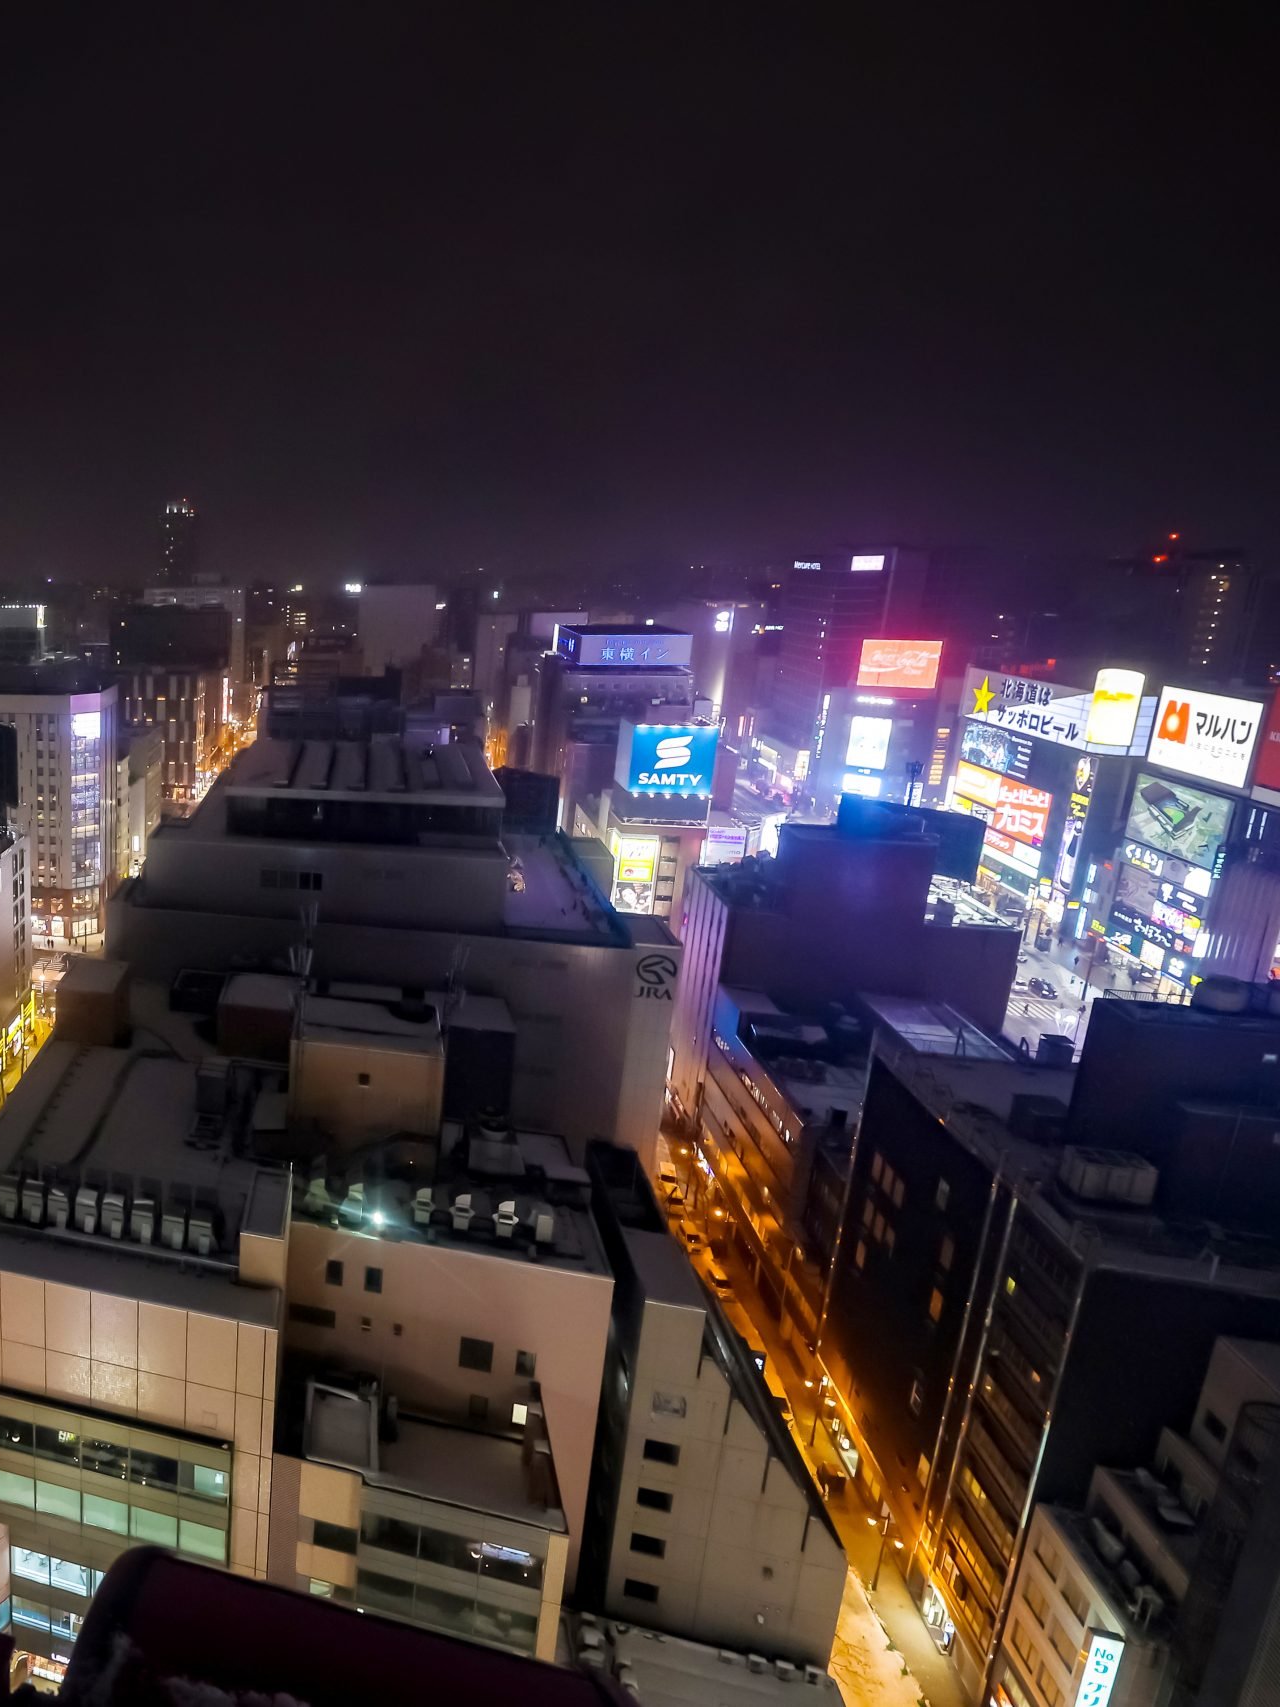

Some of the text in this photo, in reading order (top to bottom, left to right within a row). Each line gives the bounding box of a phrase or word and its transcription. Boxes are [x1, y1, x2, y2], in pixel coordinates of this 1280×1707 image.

[601, 647, 670, 661] 東横イン
[1000, 679, 1053, 706] 北海道は
[996, 703, 1079, 742] サッポロビール
[1196, 711, 1253, 745] マルハン
[638, 772, 703, 786] SAMTY
[994, 804, 1045, 837] プロミス
[634, 986, 672, 1001] JRA
